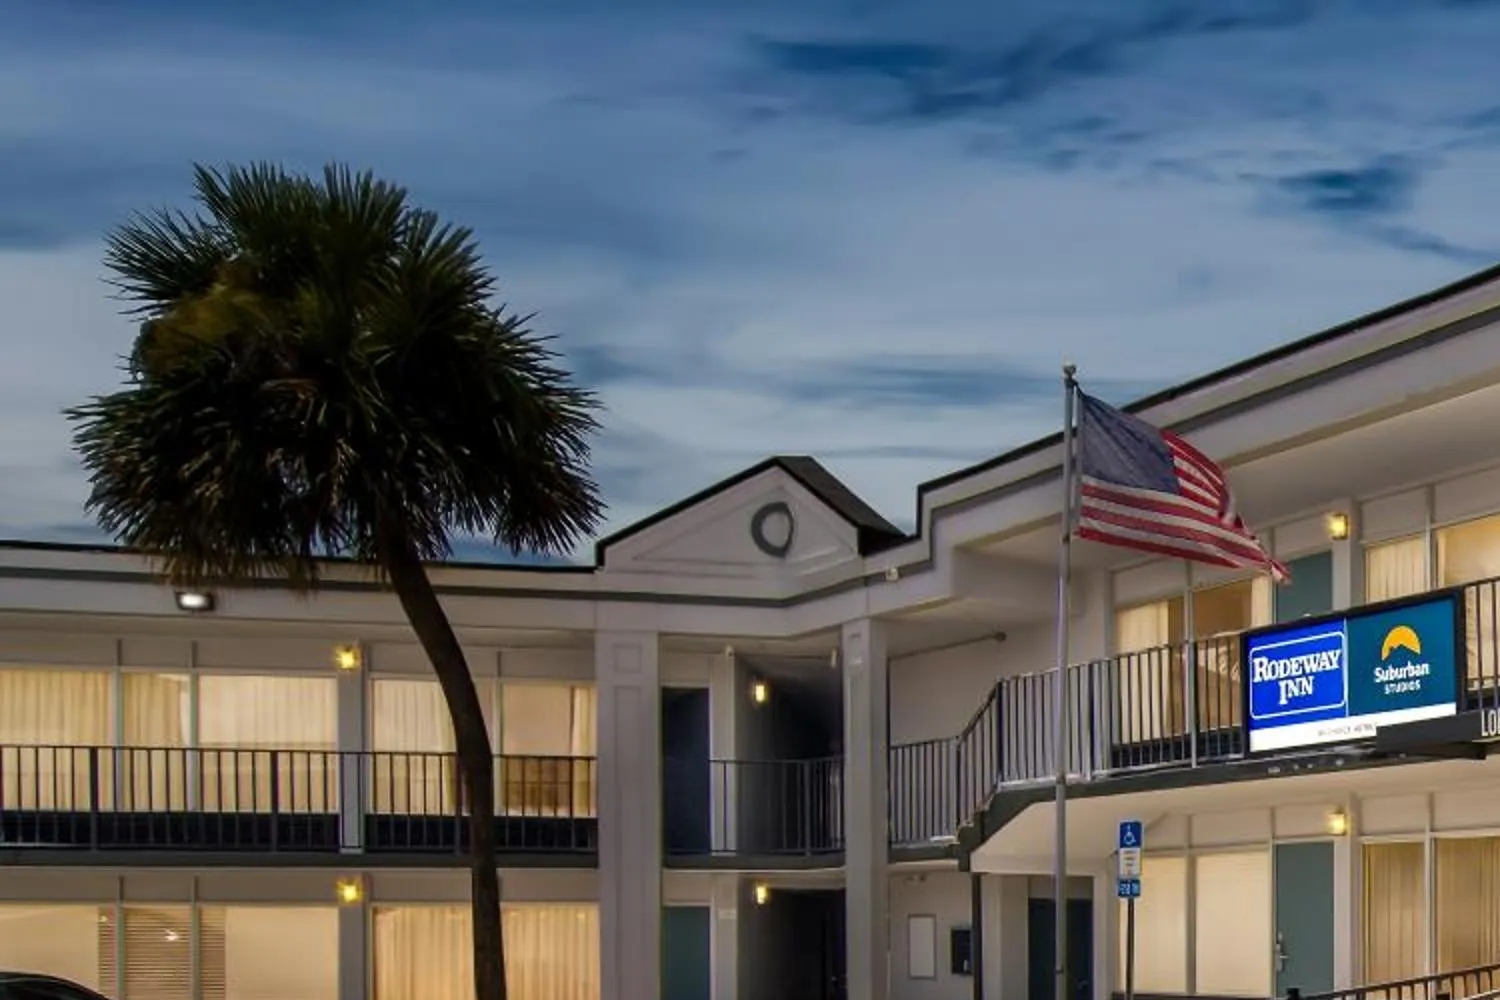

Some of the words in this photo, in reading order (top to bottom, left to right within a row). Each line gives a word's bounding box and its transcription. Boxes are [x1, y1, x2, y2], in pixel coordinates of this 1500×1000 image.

[1253, 649, 1342, 683] RODEWAY
[1373, 660, 1430, 683] Suburban
[1278, 675, 1315, 705] INN
[1384, 679, 1421, 695] STUDIOS
